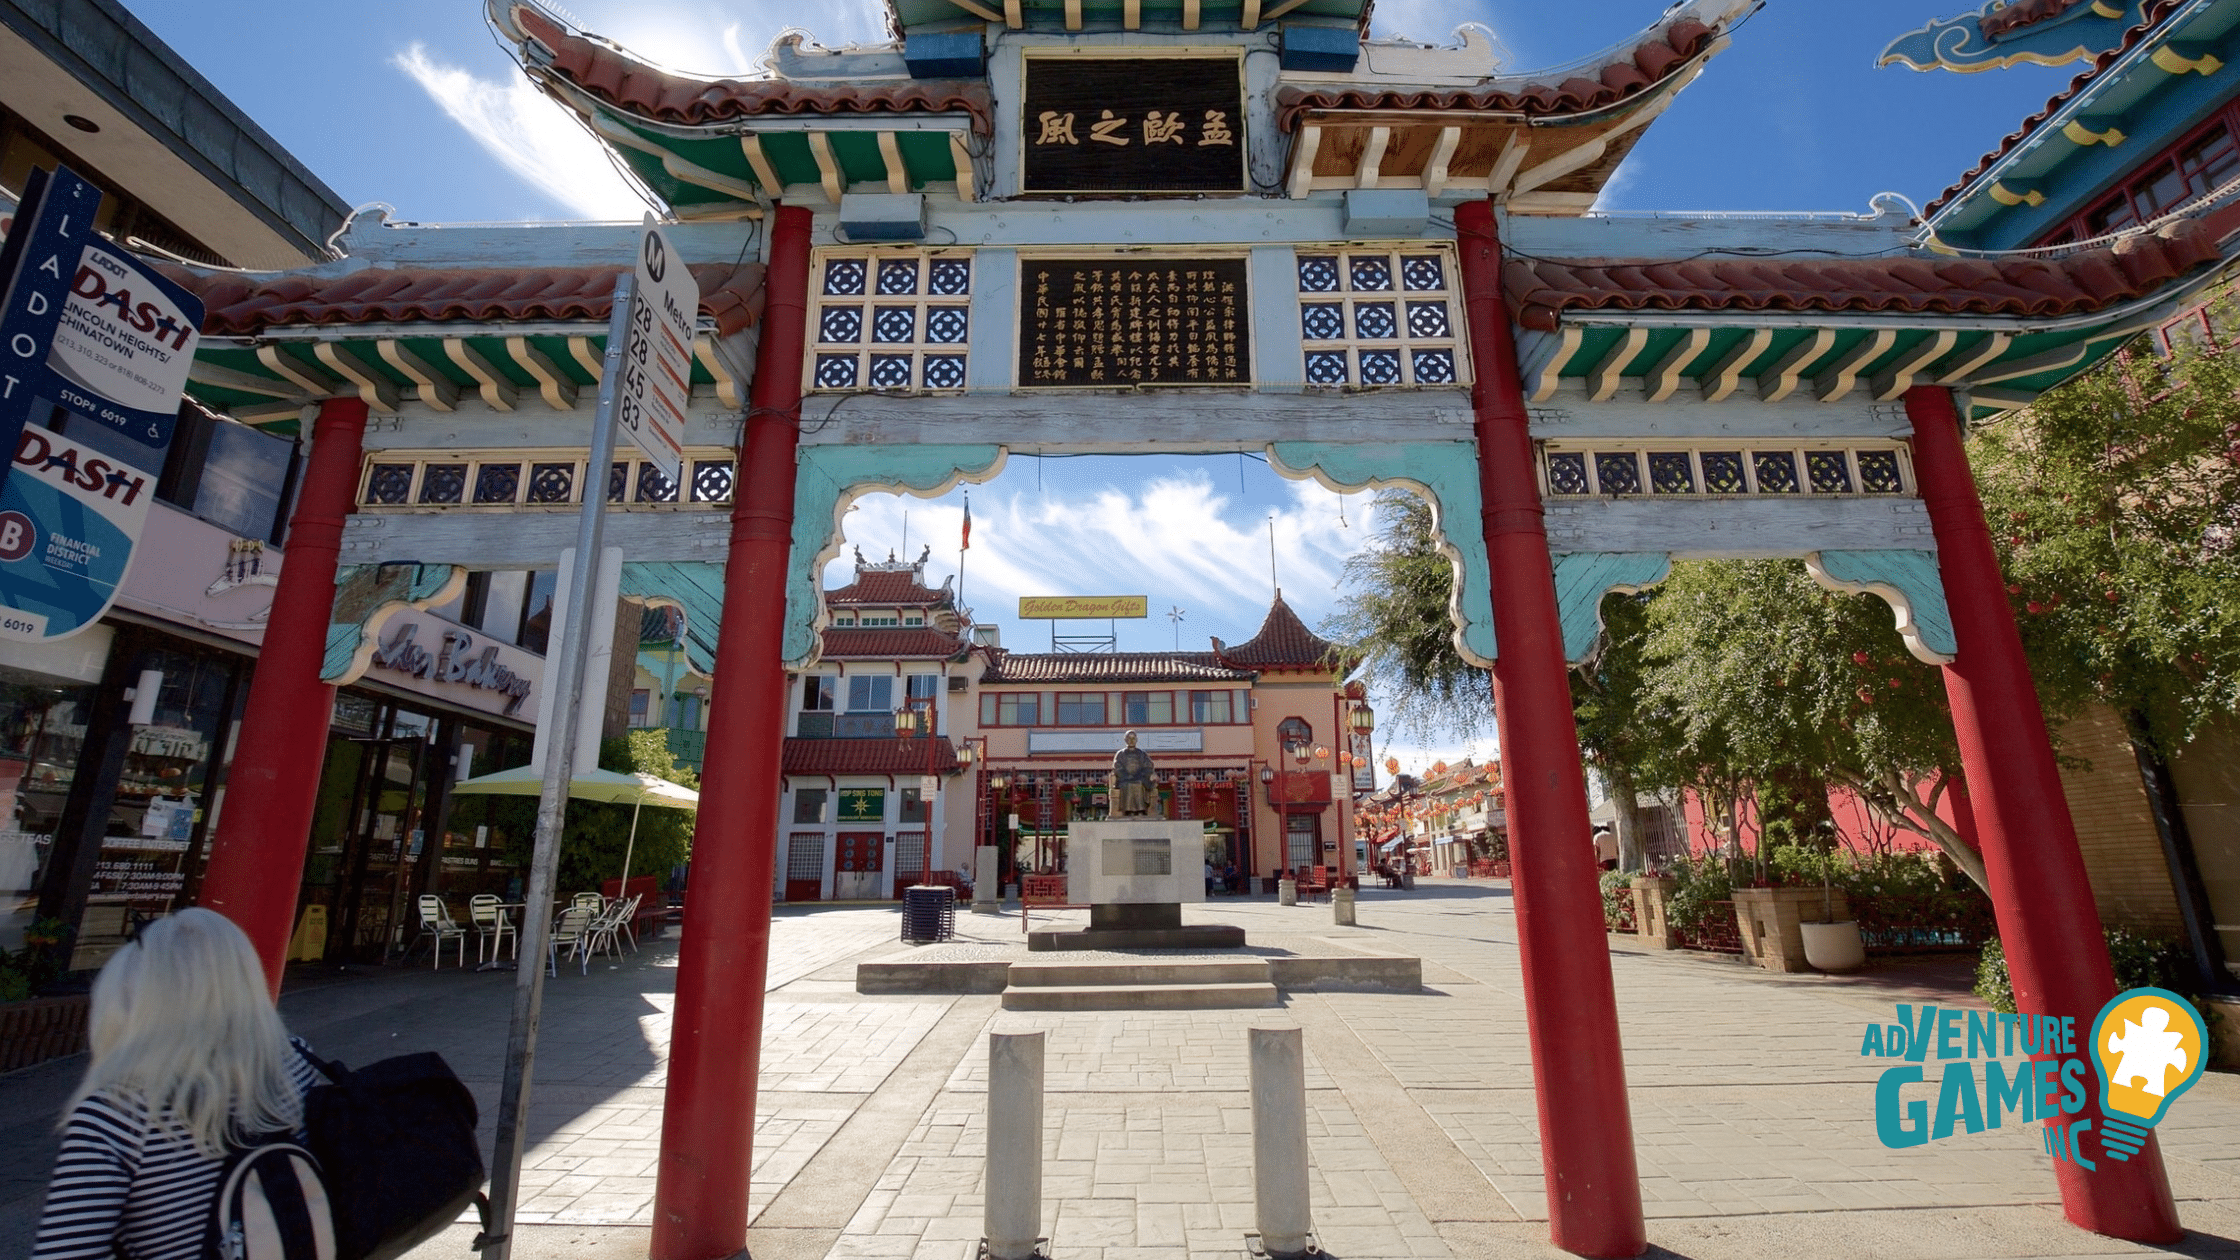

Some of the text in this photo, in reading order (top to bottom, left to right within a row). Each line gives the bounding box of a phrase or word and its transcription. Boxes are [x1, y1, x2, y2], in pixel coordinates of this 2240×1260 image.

[90, 252, 128, 279] LADOT
[63, 302, 117, 336] LINCOLN
[69, 264, 193, 352] DASH
[634, 297, 652, 333] 28
[663, 289, 692, 341] Metro
[60, 313, 134, 360] CHINATOWN
[630, 329, 648, 366] 28
[77, 344, 94, 359] 310,
[94, 353, 109, 367] 323
[117, 365, 134, 379] 818)
[133, 373, 165, 395] 808-2273
[626, 365, 645, 400] 45
[60, 389, 127, 427] STOP# 6019
[621, 395, 640, 432] 83
[11, 429, 145, 507] DASH
[0, 519, 23, 551] B
[50, 532, 101, 557] FINANCIAL
[44, 556, 74, 570] WEEKDAY
[47, 543, 91, 566] DISTRICT
[1023, 599, 1141, 616] Golden Dragon Gifts
[4, 618, 35, 634] 6019
[434, 631, 532, 716] Bakery
[19, 833, 52, 845] TEAS
[101, 836, 191, 851] COFFEE INTERNET
